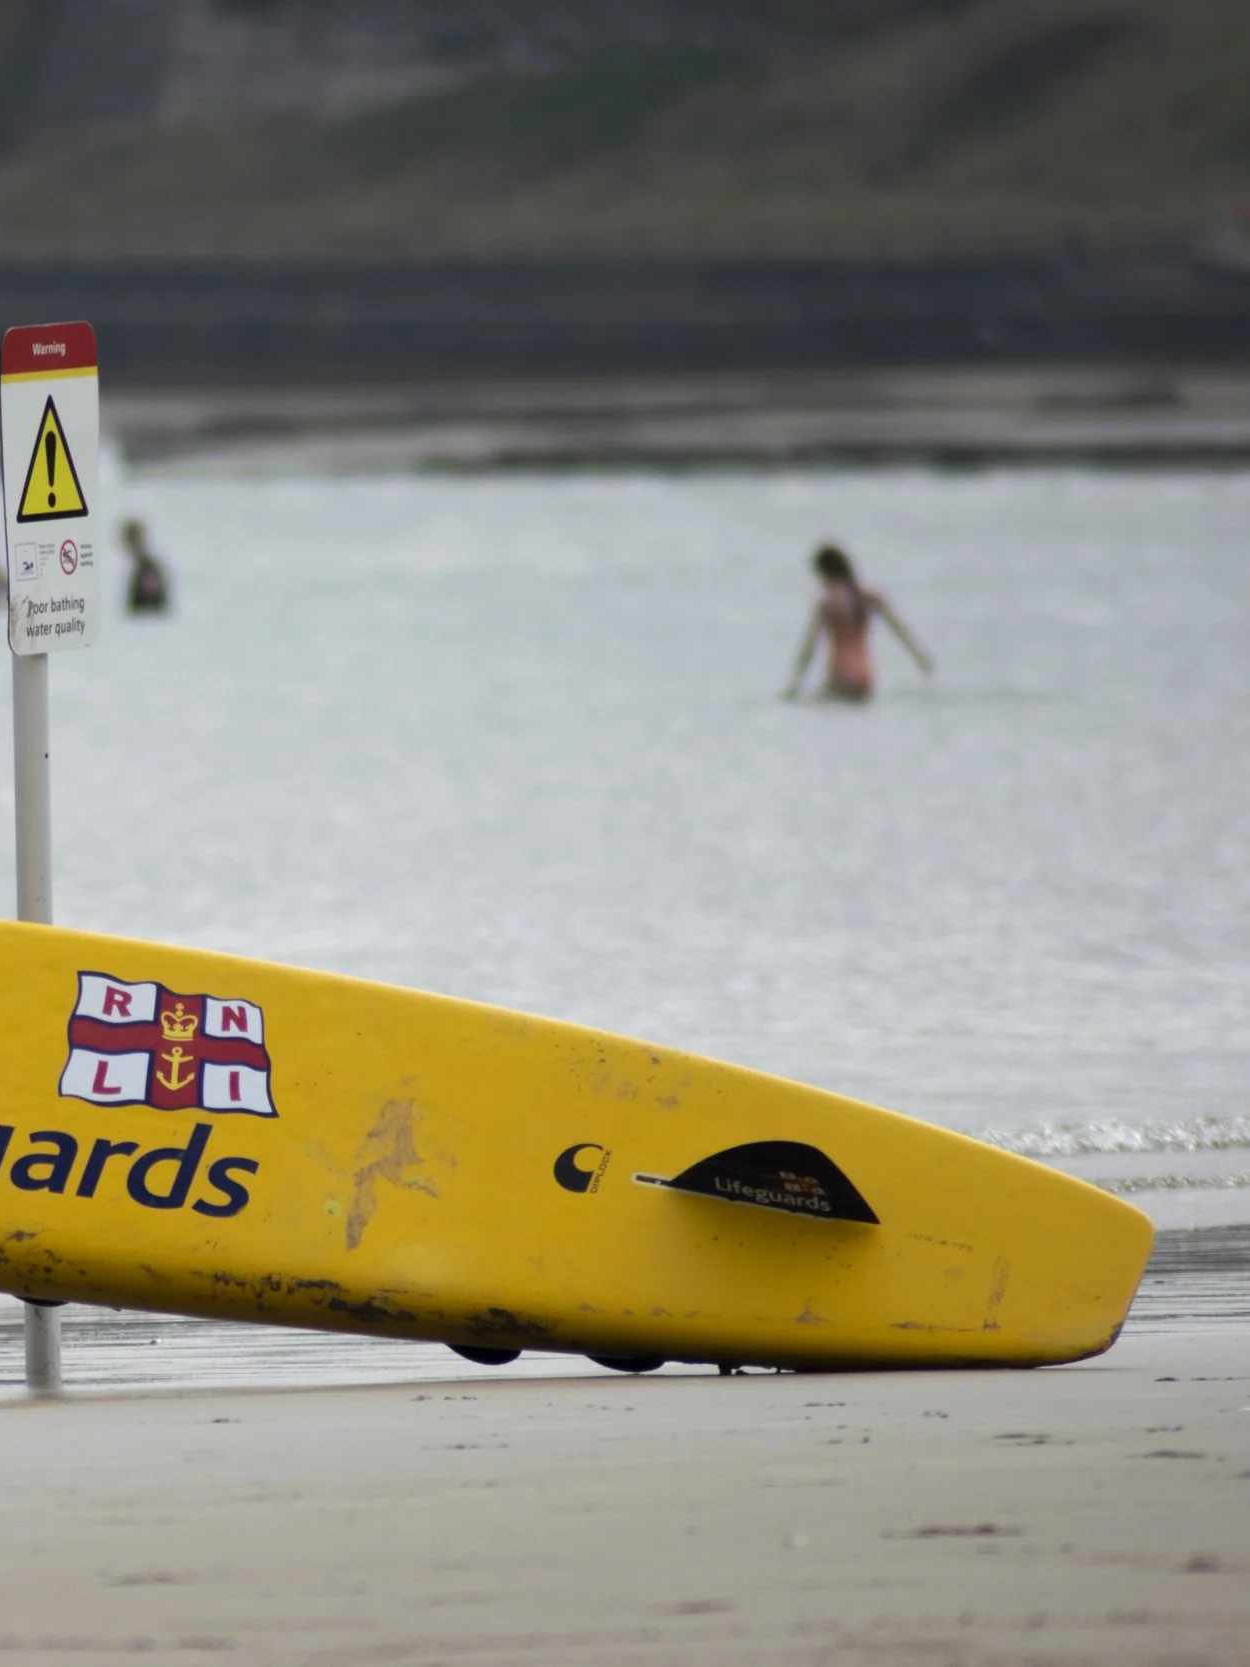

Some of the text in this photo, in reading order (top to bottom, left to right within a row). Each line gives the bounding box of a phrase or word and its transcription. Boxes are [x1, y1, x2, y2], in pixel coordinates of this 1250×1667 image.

[32, 341, 66, 356] Warning
[27, 596, 85, 615] Poor bathing
[26, 617, 85, 637] water quality
[714, 1176, 832, 1212] Lifeguards
